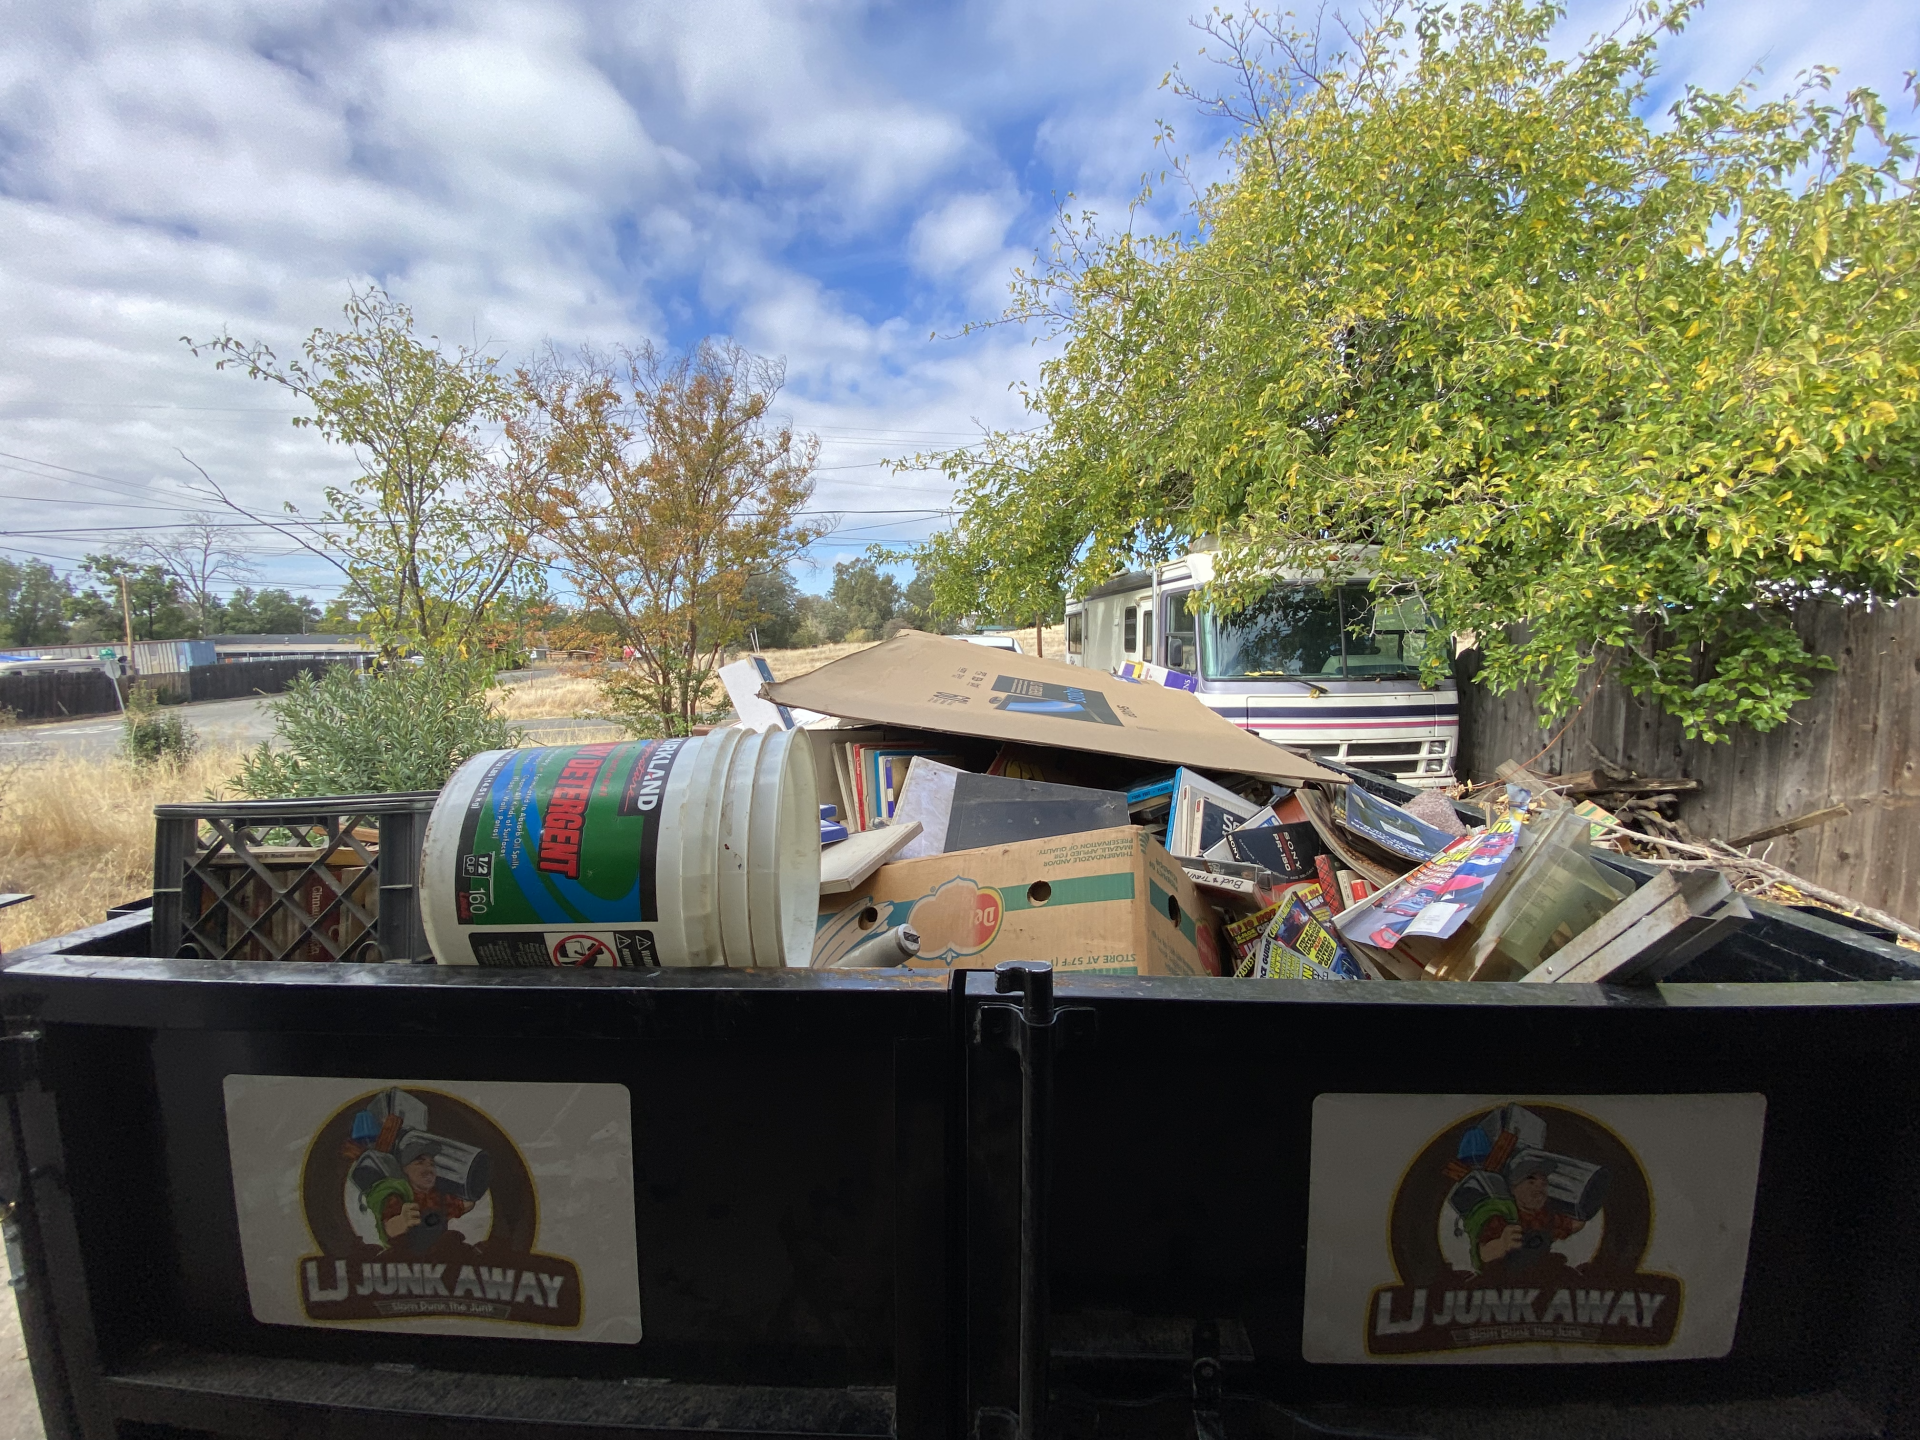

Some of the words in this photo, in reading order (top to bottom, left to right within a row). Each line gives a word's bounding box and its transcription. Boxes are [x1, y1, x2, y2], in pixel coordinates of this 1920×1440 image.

[486, 767, 500, 779] LBS
[637, 739, 683, 811] KIRKLAND
[515, 812, 526, 836] Absorb
[540, 758, 604, 878] DETERGENT
[500, 828, 511, 857] Surfaces
[513, 837, 522, 849] Oil
[1037, 846, 1067, 855] QUALITY.
[1080, 838, 1134, 849] PRESERVATION
[1101, 845, 1133, 853] IMAZALIL
[1228, 834, 1241, 860] SONY
[1283, 831, 1303, 870] SONY
[511, 850, 520, 870] Spills
[1070, 848, 1099, 857] APPLIED
[1072, 851, 1133, 863] THIABENDAZOLE
[466, 857, 475, 874] CUP
[477, 857, 488, 874] 1/2
[1043, 858, 1072, 867] AND/OR
[1220, 877, 1244, 889] Bud
[469, 888, 487, 914] 160
[970, 906, 996, 927] De
[1268, 923, 1279, 938] CARS
[1303, 923, 1319, 953] INTERIOR
[1306, 926, 1321, 956] UPGRADES
[1315, 936, 1327, 960] STEREO
[1087, 955, 1100, 965] AT
[1103, 954, 1136, 964] STORE
[1263, 938, 1272, 965] GUIDE
[1324, 947, 1334, 966] GUIDE
[1061, 956, 1084, 967] 57°F
[356, 1262, 450, 1296] JUNK
[453, 1264, 564, 1308] AWAY
[391, 1302, 418, 1311] Slam
[420, 1302, 446, 1311] Dunk
[448, 1302, 467, 1311] the
[469, 1303, 494, 1313] Junk
[1433, 1288, 1541, 1325] JUNK
[1540, 1288, 1666, 1328] AWAY
